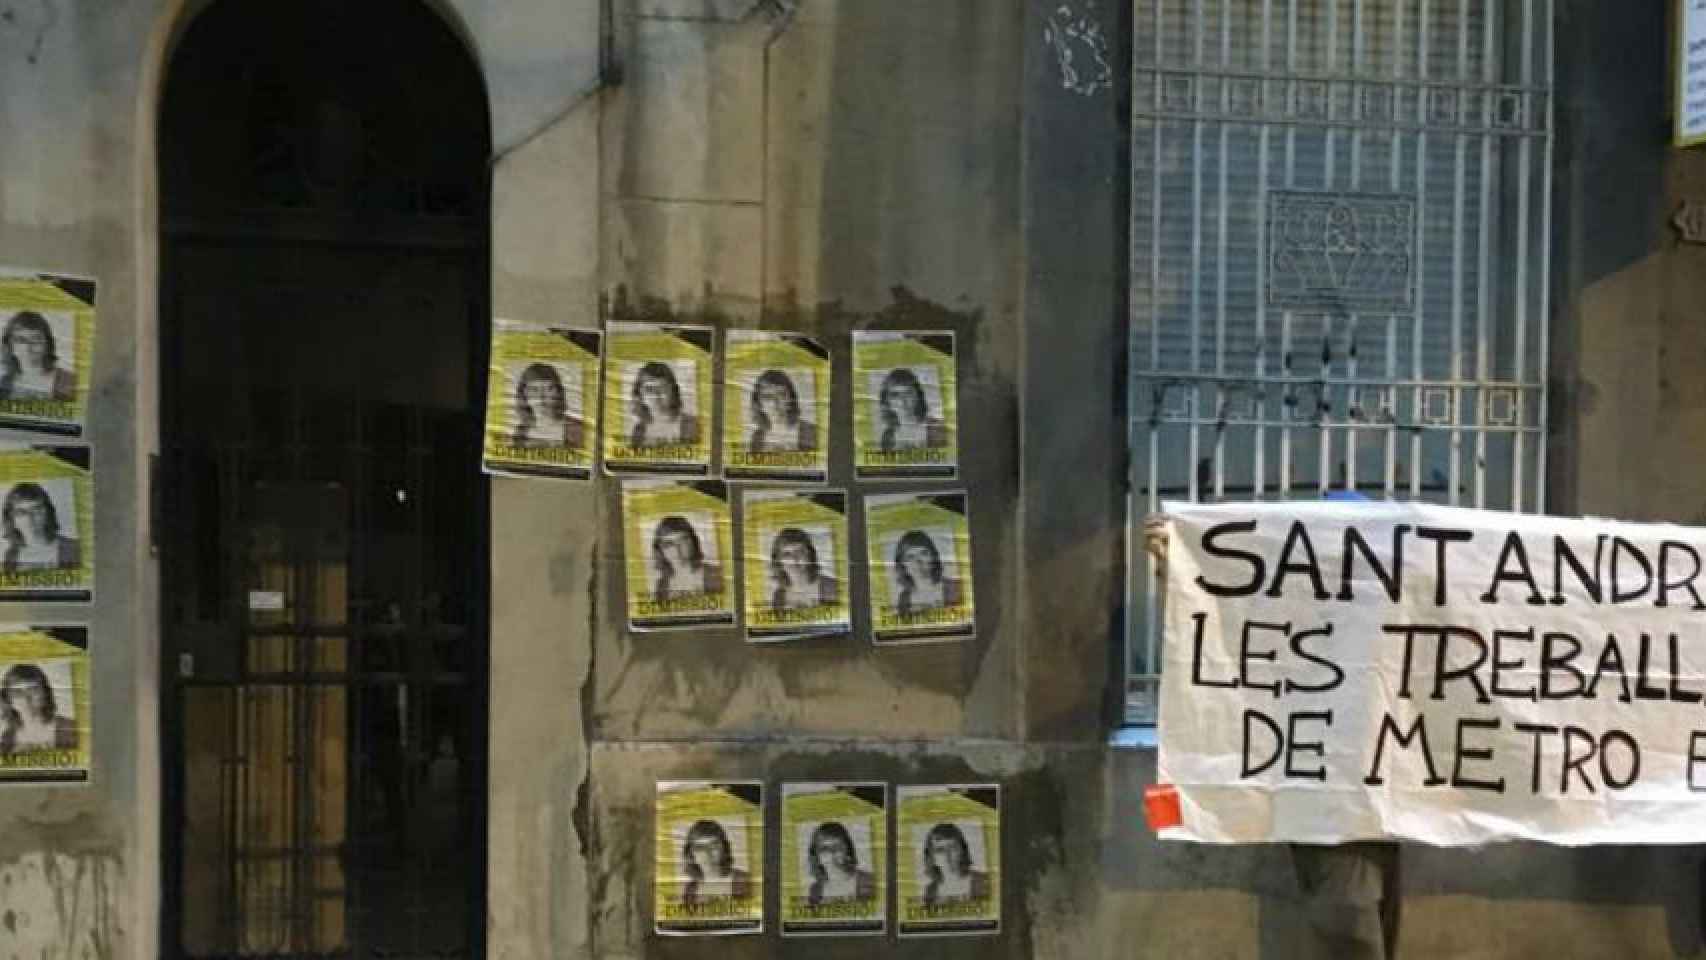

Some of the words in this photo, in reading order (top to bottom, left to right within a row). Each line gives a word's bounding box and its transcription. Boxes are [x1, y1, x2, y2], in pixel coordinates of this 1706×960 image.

[1191, 612, 1345, 698] LES
[1382, 623, 1706, 704] TREBALL
[1240, 708, 1333, 782] DE
[1363, 711, 1641, 795] METRO
